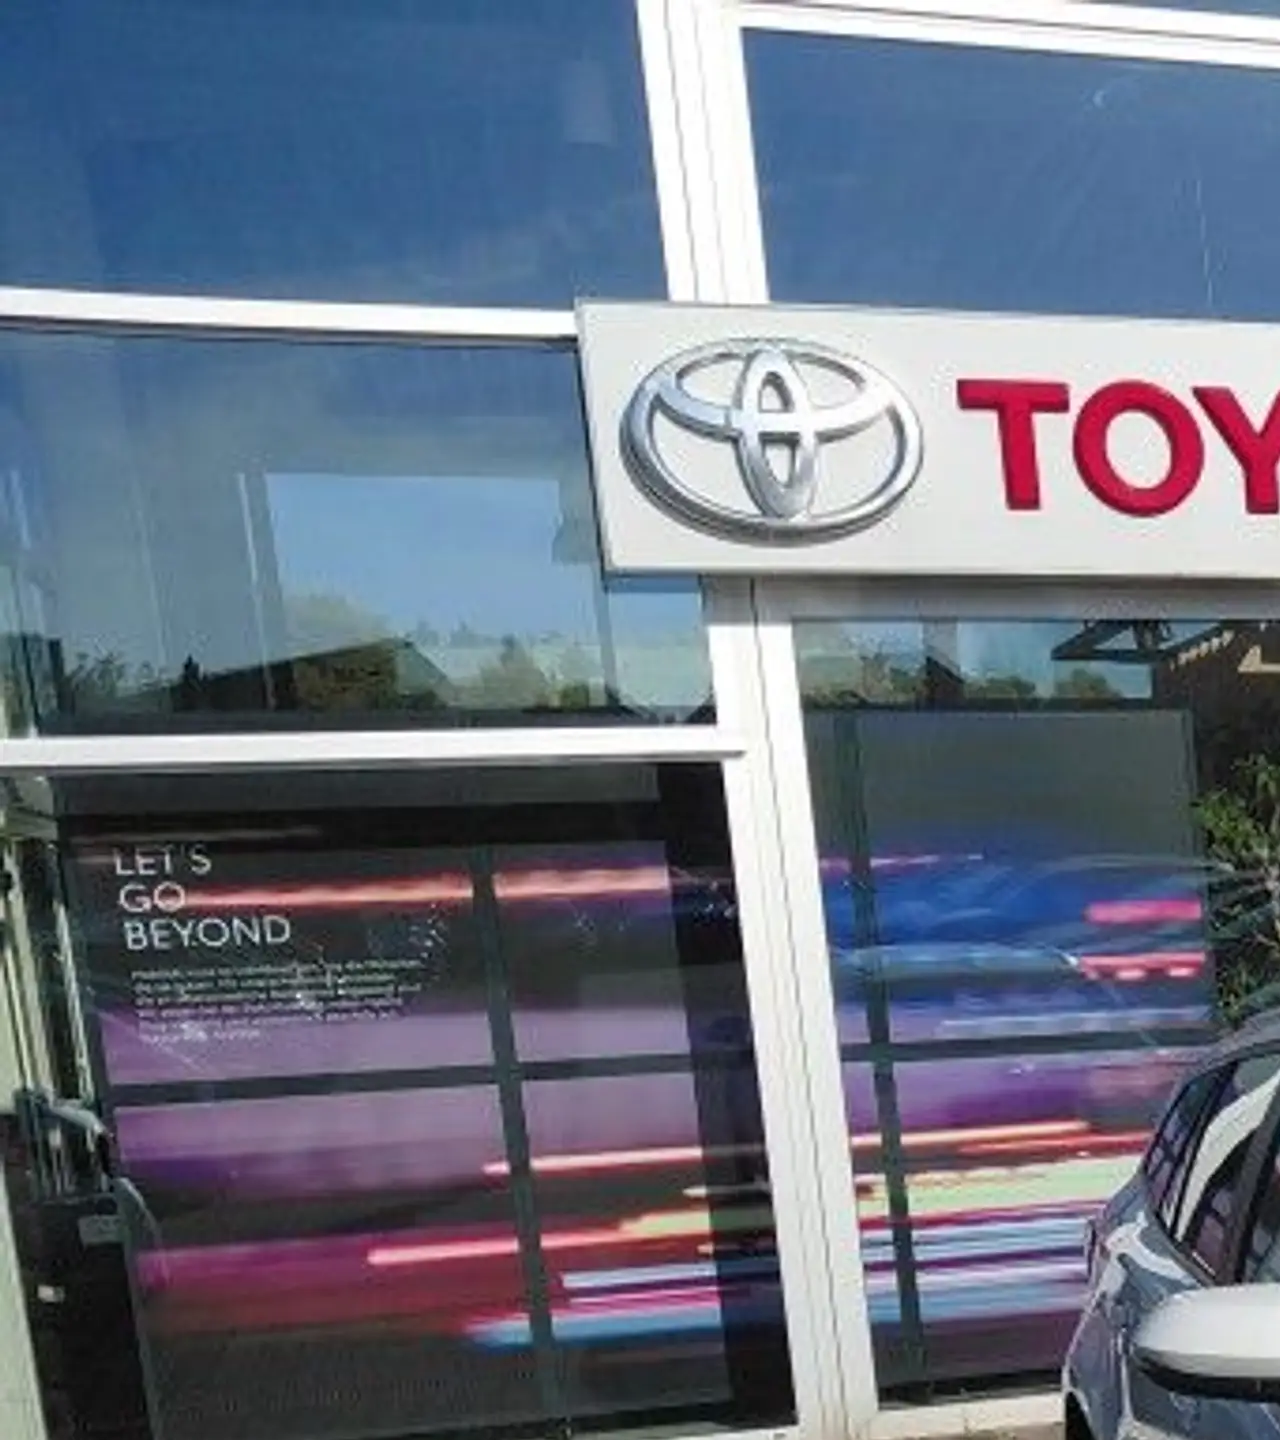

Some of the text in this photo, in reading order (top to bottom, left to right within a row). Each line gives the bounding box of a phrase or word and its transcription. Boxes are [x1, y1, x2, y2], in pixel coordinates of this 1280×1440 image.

[114, 843, 213, 876] LET'S
[119, 881, 186, 914] GO
[124, 914, 292, 951] BEYOND
